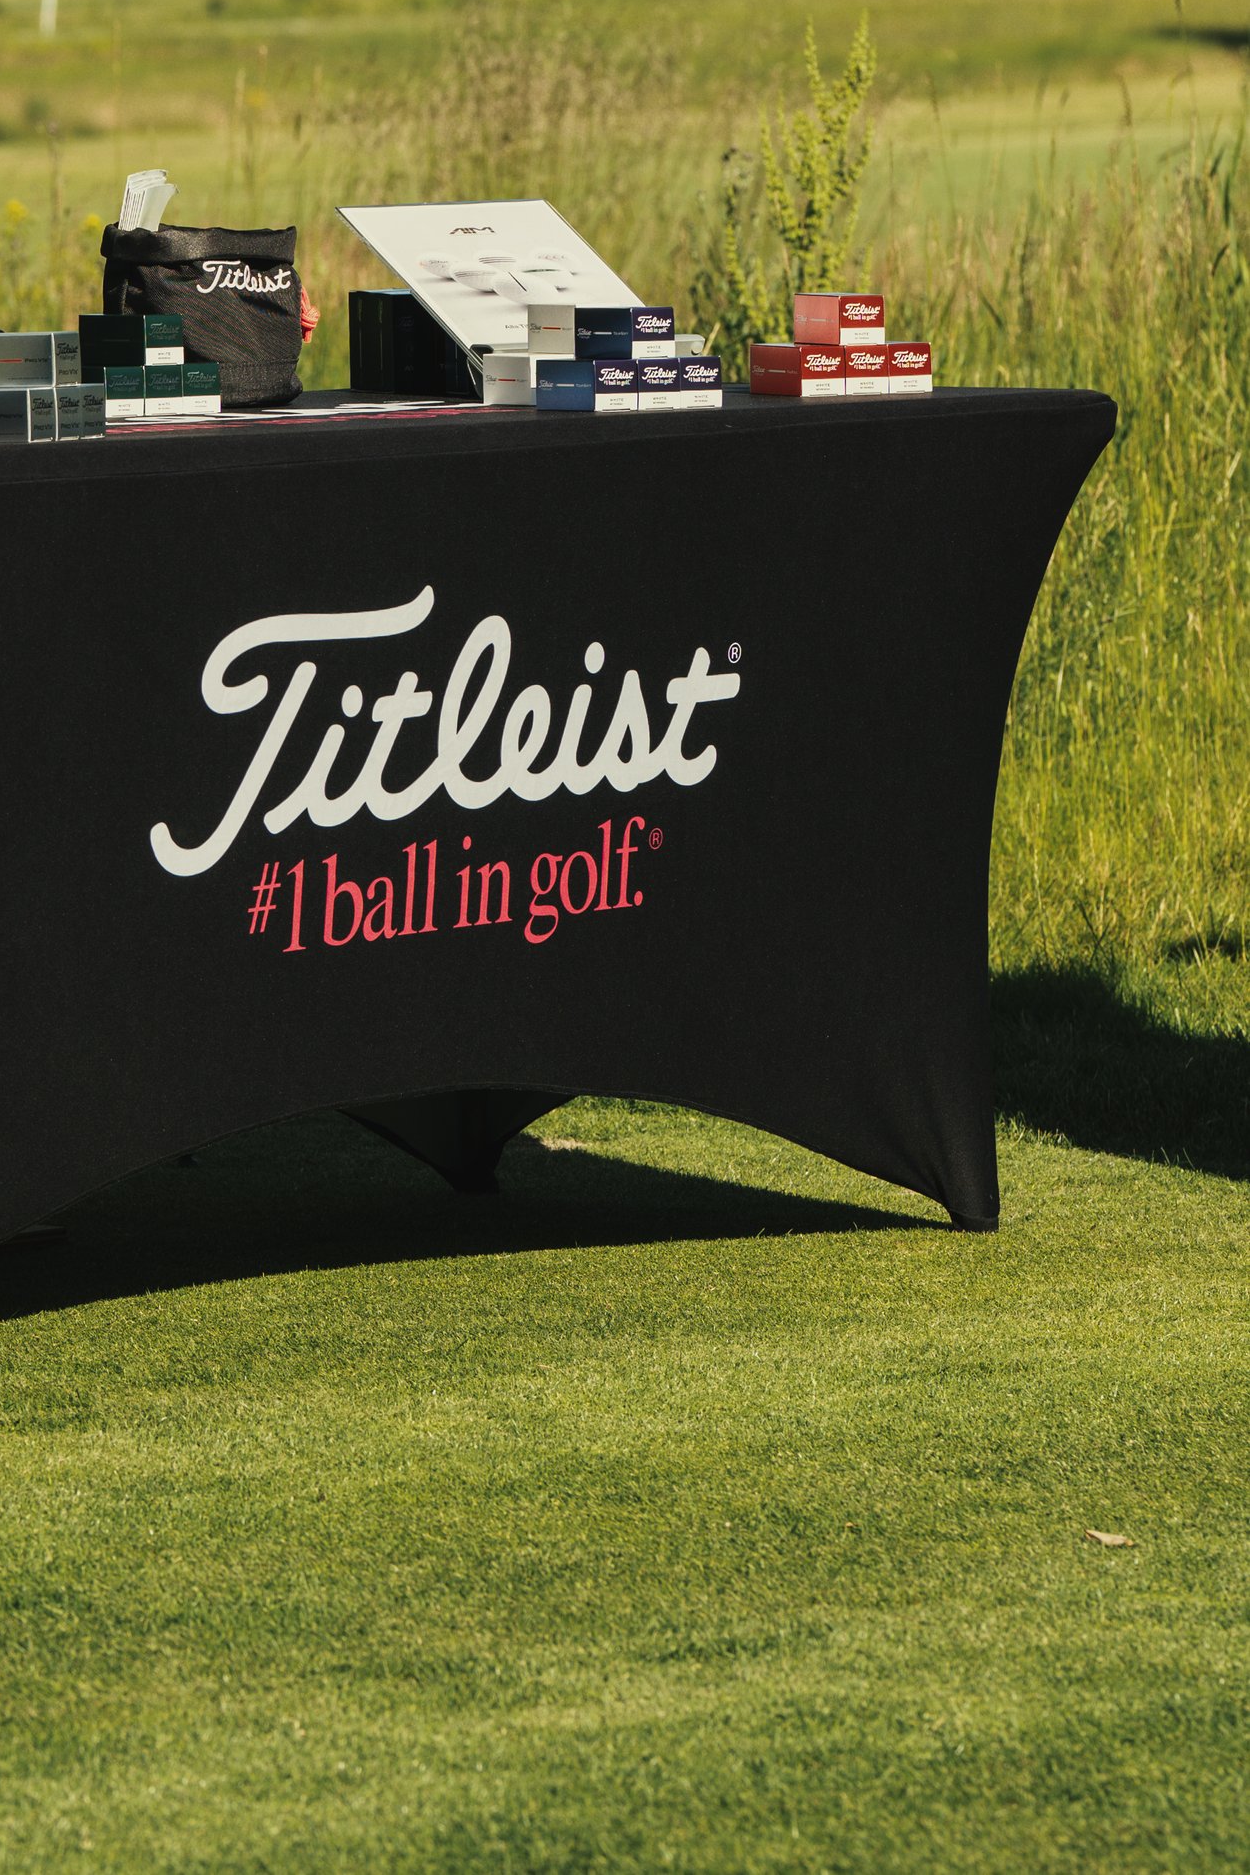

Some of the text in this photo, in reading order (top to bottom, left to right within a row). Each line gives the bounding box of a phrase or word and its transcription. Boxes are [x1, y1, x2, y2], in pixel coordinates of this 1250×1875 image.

[196, 260, 292, 294] Titleist
[635, 315, 672, 329] Titleist
[804, 354, 841, 367] Titleist
[848, 352, 885, 366] Titleist
[891, 351, 929, 364] Titleist
[598, 367, 635, 381] Titleist
[641, 366, 678, 380] Titleist
[683, 365, 719, 379] Titleist
[149, 584, 741, 877] Titleist
[247, 859, 307, 953] #1
[322, 839, 438, 947] ball
[452, 835, 513, 929] in
